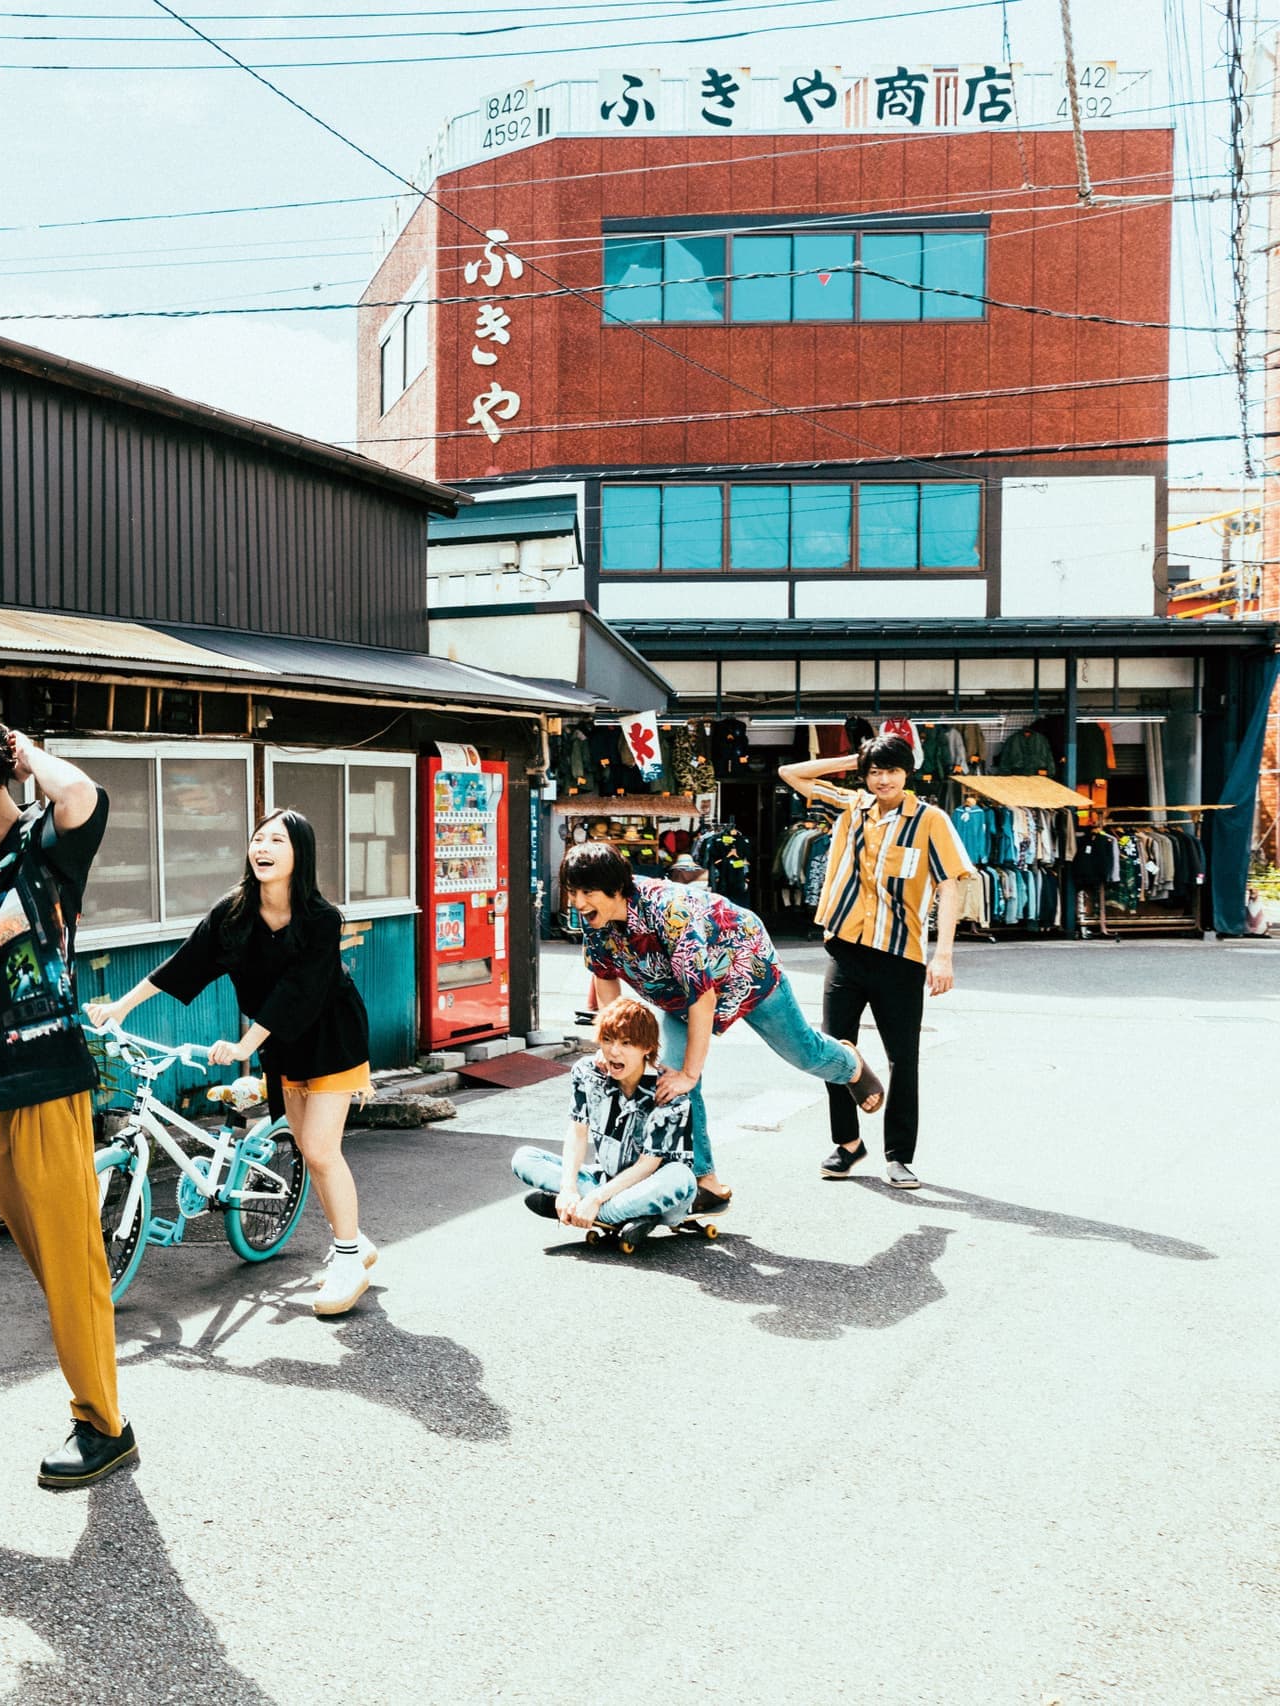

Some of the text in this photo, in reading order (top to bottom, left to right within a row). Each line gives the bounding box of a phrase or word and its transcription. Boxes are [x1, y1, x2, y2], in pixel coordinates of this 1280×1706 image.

[600, 66, 1013, 127] ふきや商店
[483, 116, 531, 148] 4592
[464, 229, 523, 444] ふきや
